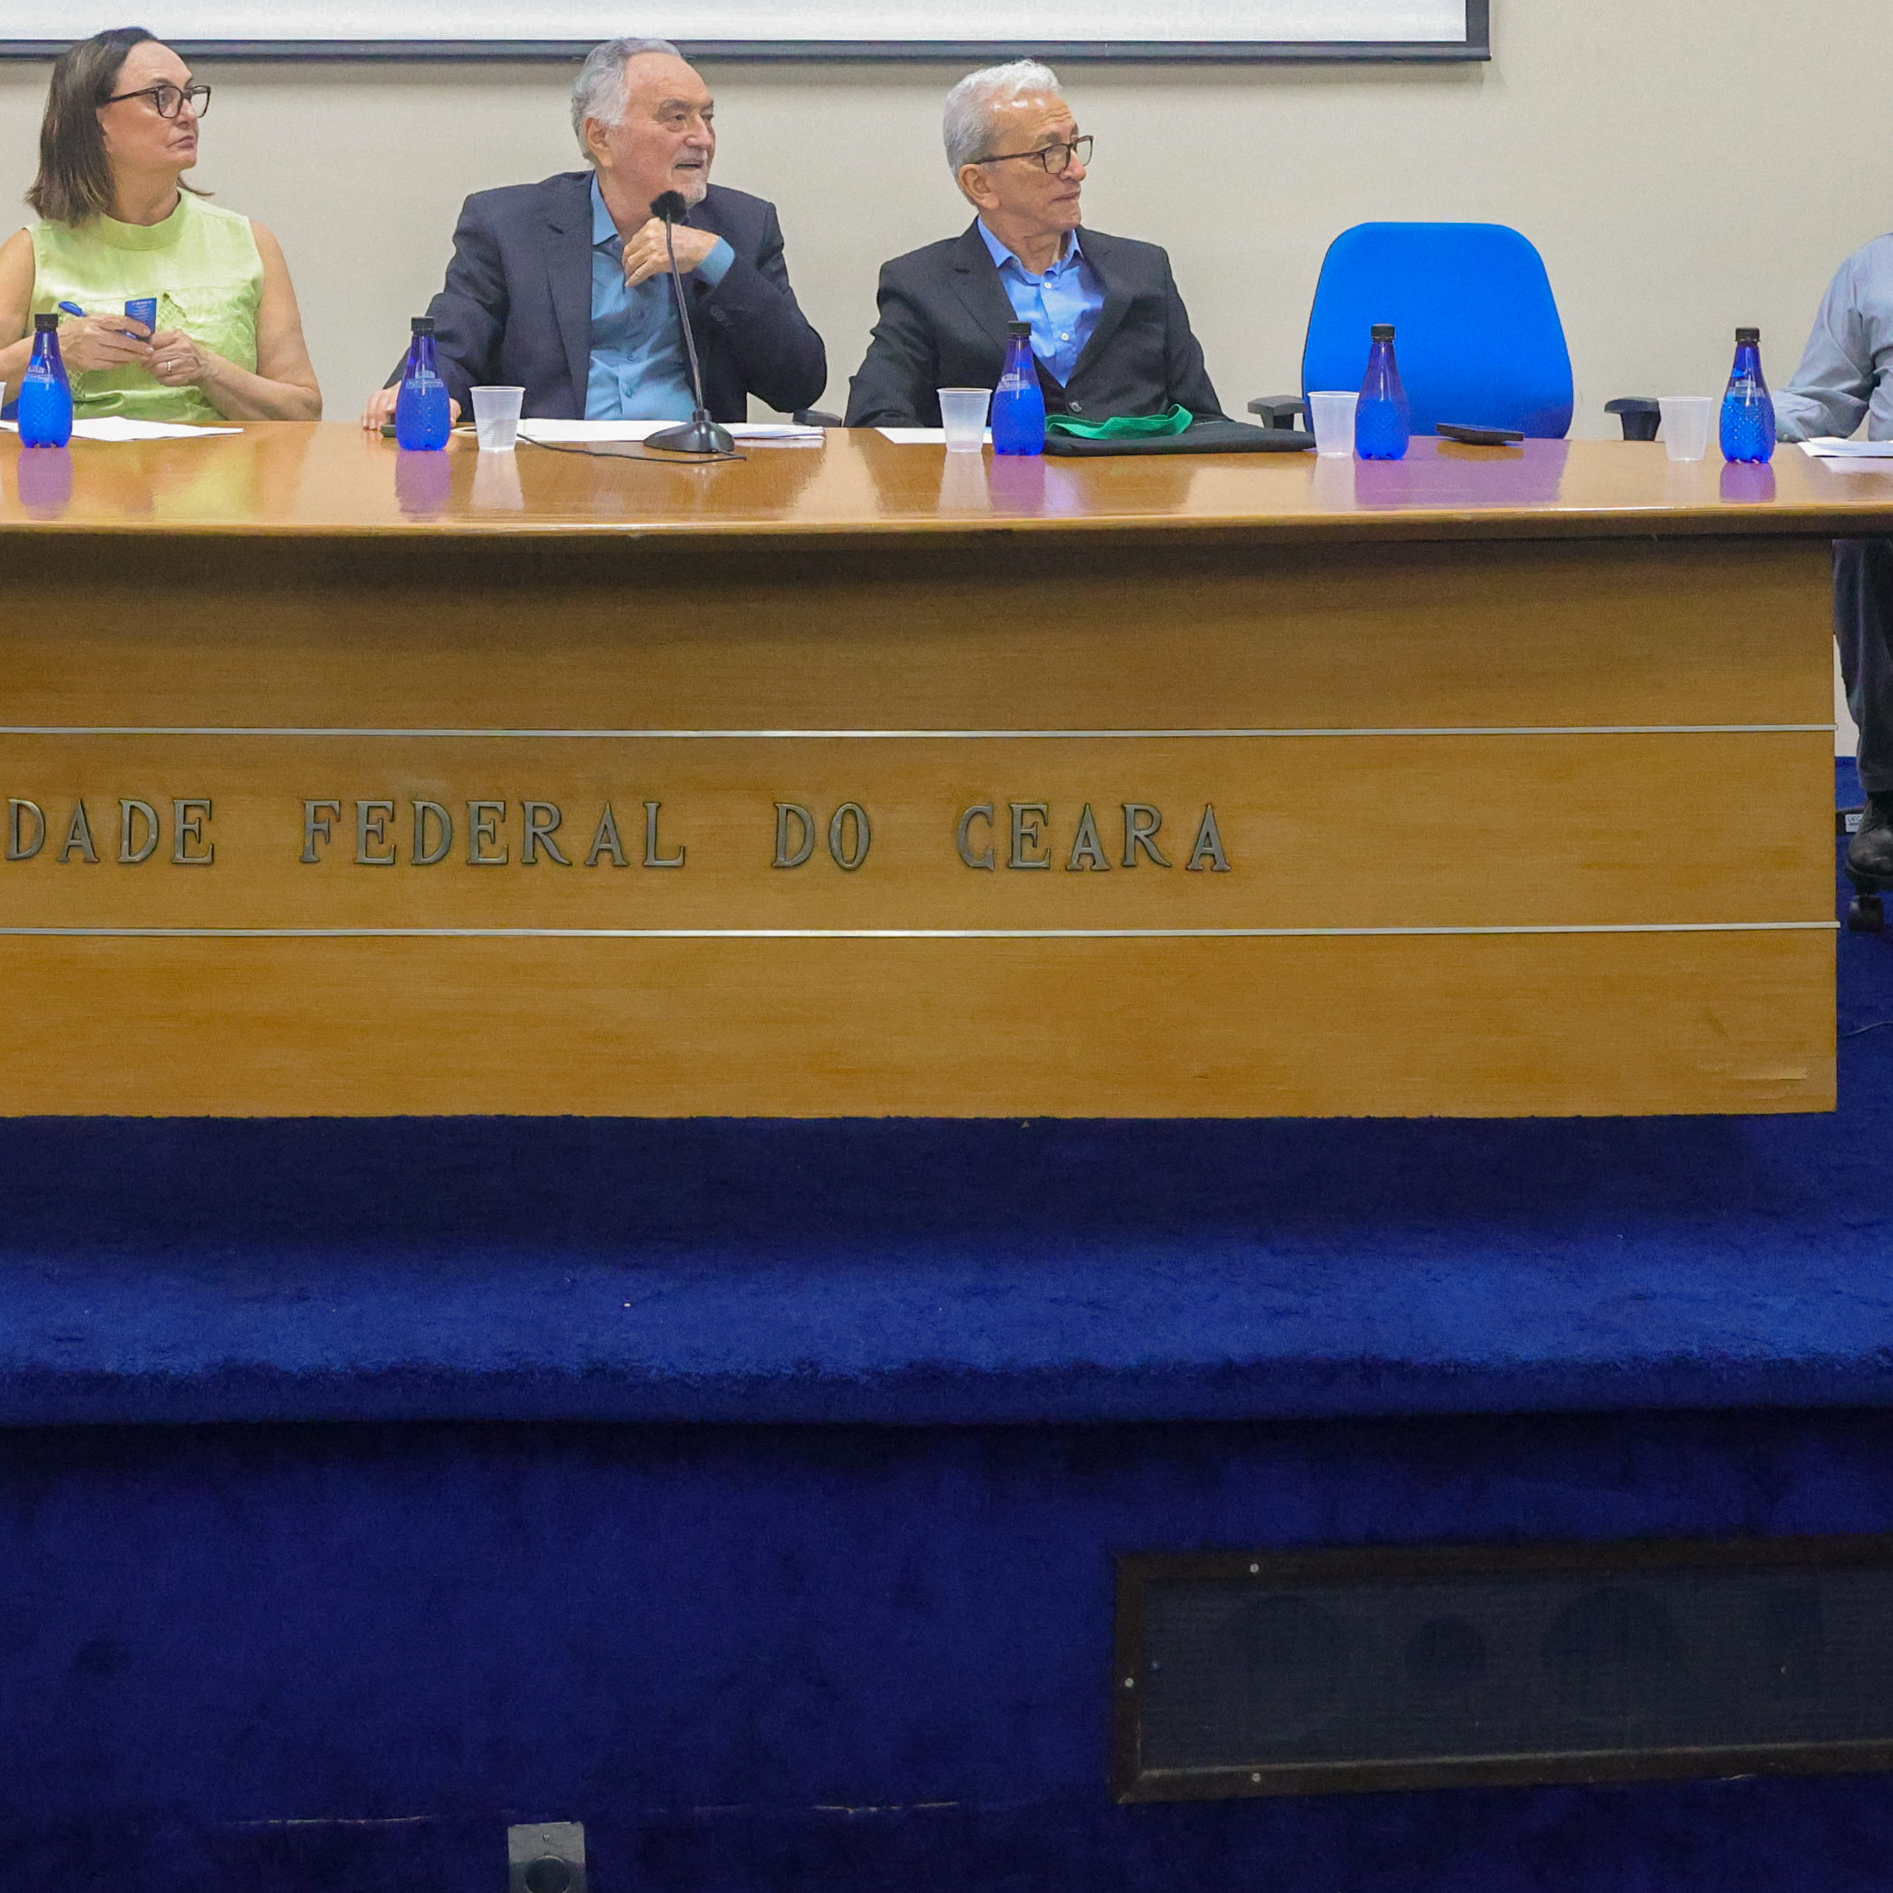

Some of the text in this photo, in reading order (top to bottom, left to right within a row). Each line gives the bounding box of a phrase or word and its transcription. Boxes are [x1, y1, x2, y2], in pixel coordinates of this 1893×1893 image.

[298, 798, 687, 869] FEDERAL
[772, 800, 872, 871] DO
[956, 802, 1234, 873] CEARA
